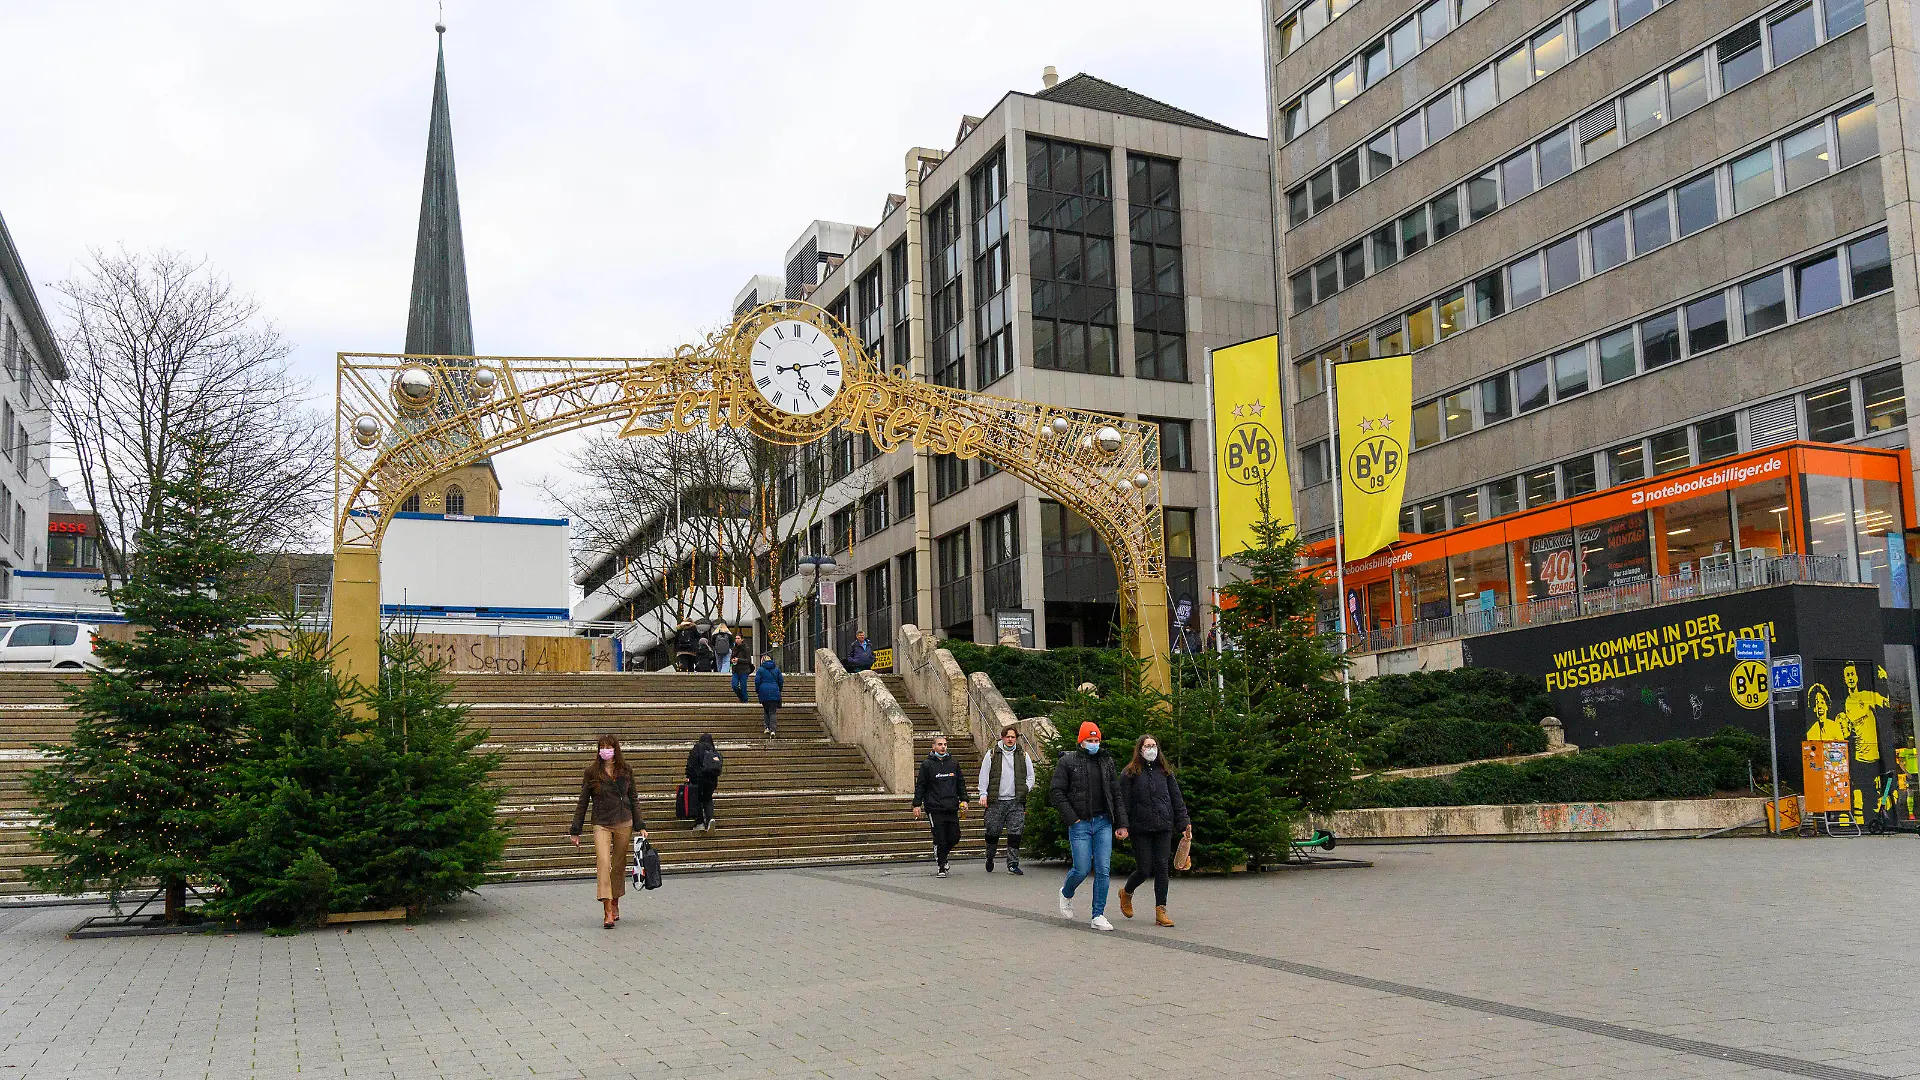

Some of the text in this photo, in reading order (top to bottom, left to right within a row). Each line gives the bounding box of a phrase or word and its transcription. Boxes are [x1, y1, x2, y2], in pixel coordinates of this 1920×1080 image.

[618, 368, 986, 460] Zeit Reise
[1228, 427, 1271, 469] BVB
[1355, 439, 1398, 479] BVB
[1243, 465, 1260, 480] 09
[1370, 474, 1385, 489] 09
[1645, 457, 1783, 503] notebooksbilliger.de
[1558, 528, 1601, 548] WEEND
[1553, 613, 1722, 670] WILLKOMMEN IN DER
[468, 643, 527, 672] Serok
[1735, 664, 1768, 695] BVB
[1746, 693, 1759, 704] 09
